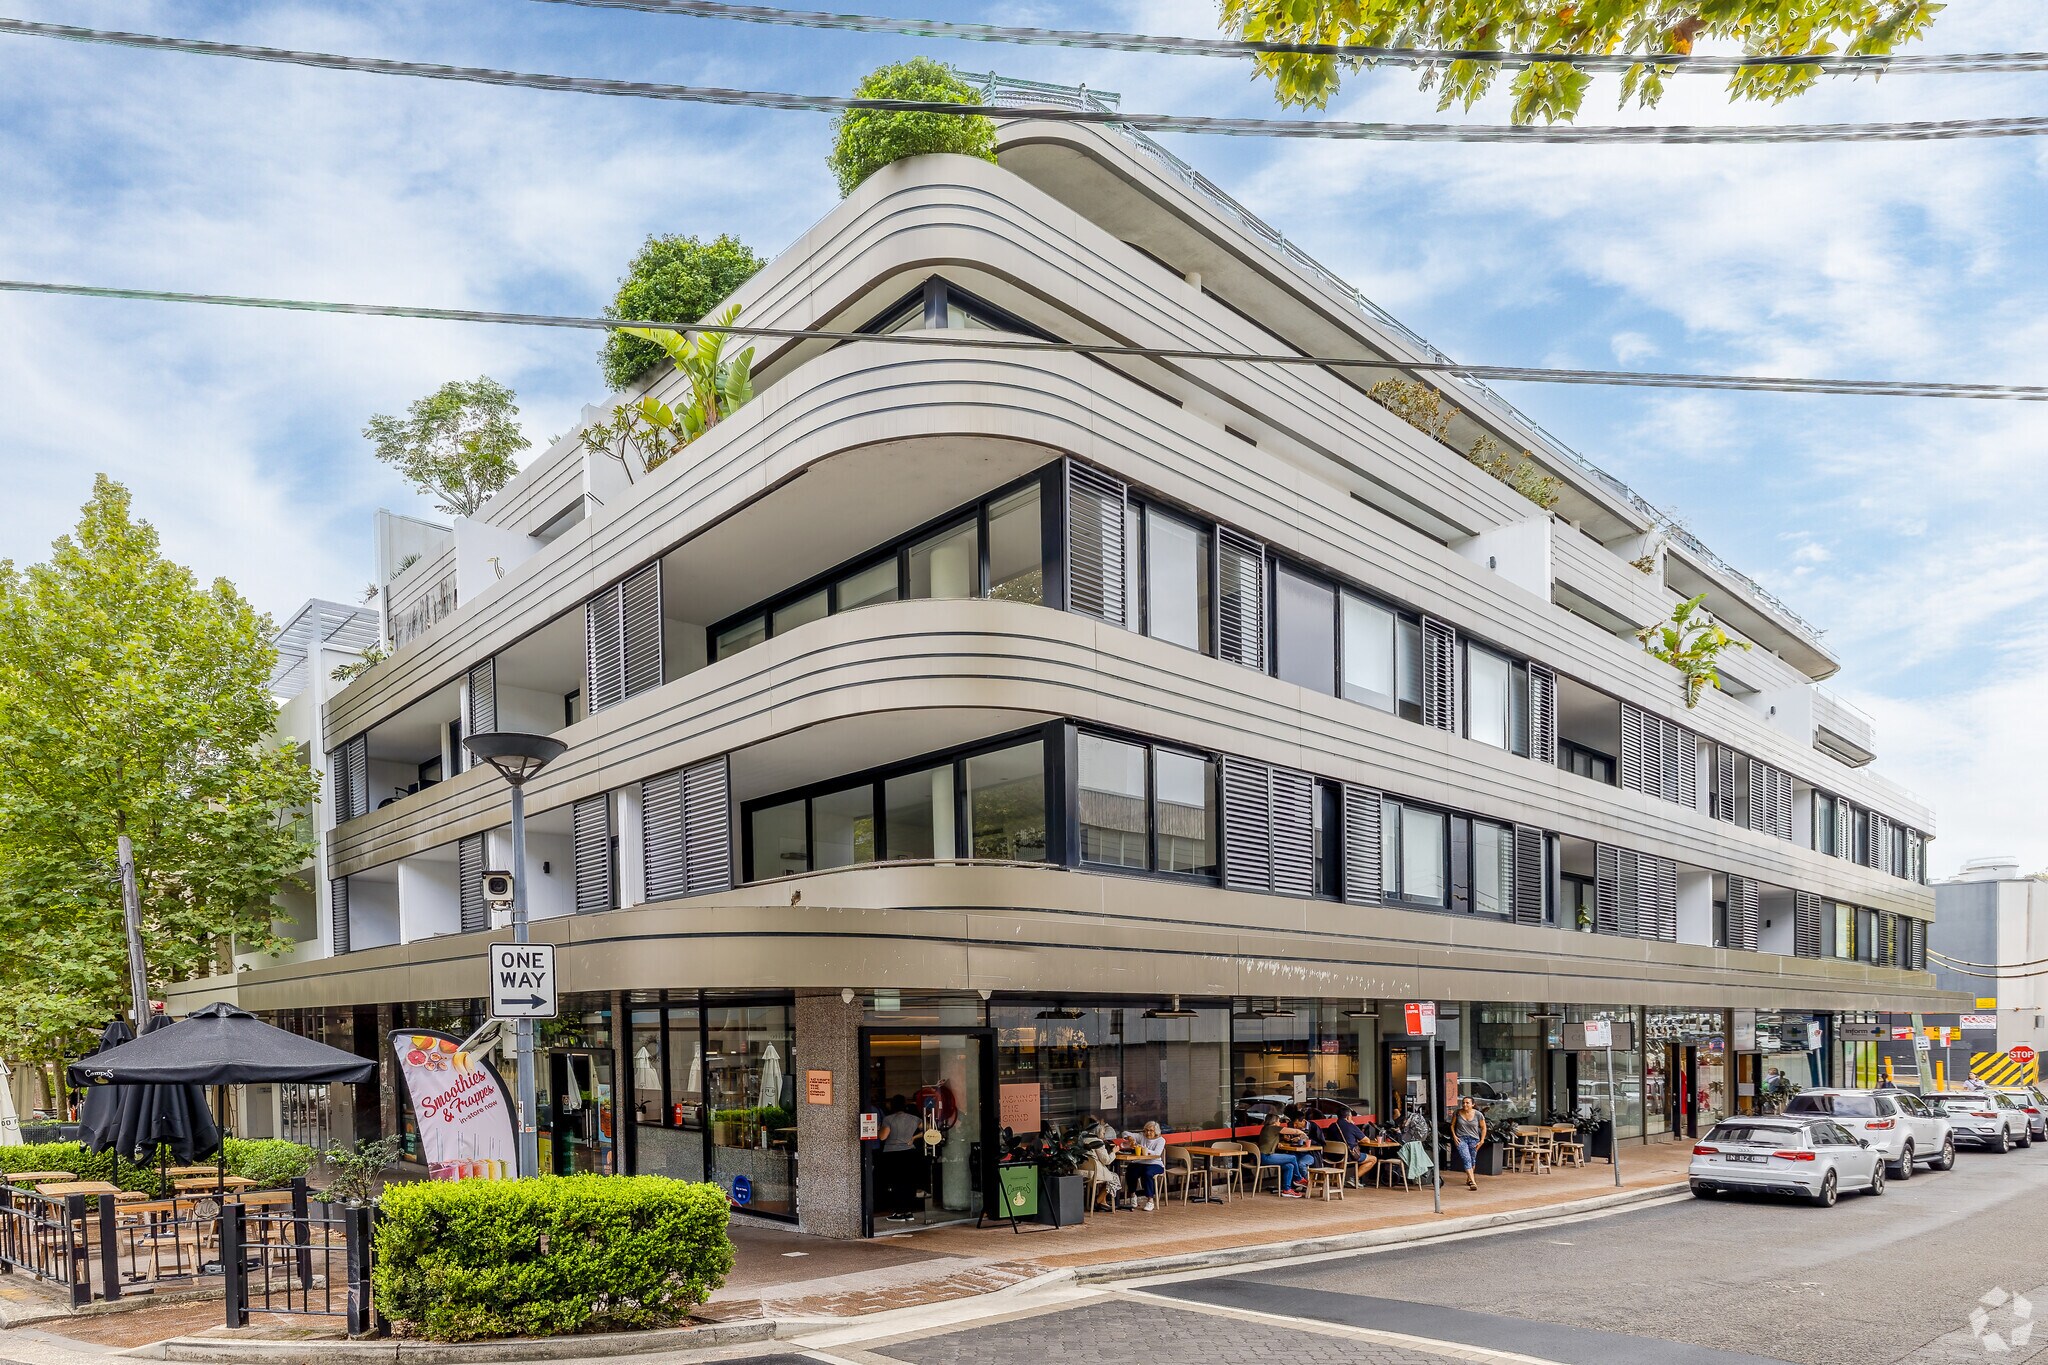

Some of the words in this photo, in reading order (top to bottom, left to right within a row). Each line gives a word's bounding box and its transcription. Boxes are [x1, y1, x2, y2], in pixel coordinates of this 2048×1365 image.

[501, 952, 544, 968] ONE
[500, 972, 546, 988] WAY
[421, 1070, 486, 1118] Smoothies
[1002, 1094, 1038, 1103] AGAINST
[443, 1108, 454, 1122] &
[449, 1085, 494, 1113] Frappes
[459, 1107, 484, 1124] in-store
[485, 1100, 498, 1111] now
[1002, 1113, 1028, 1122] GRIND
